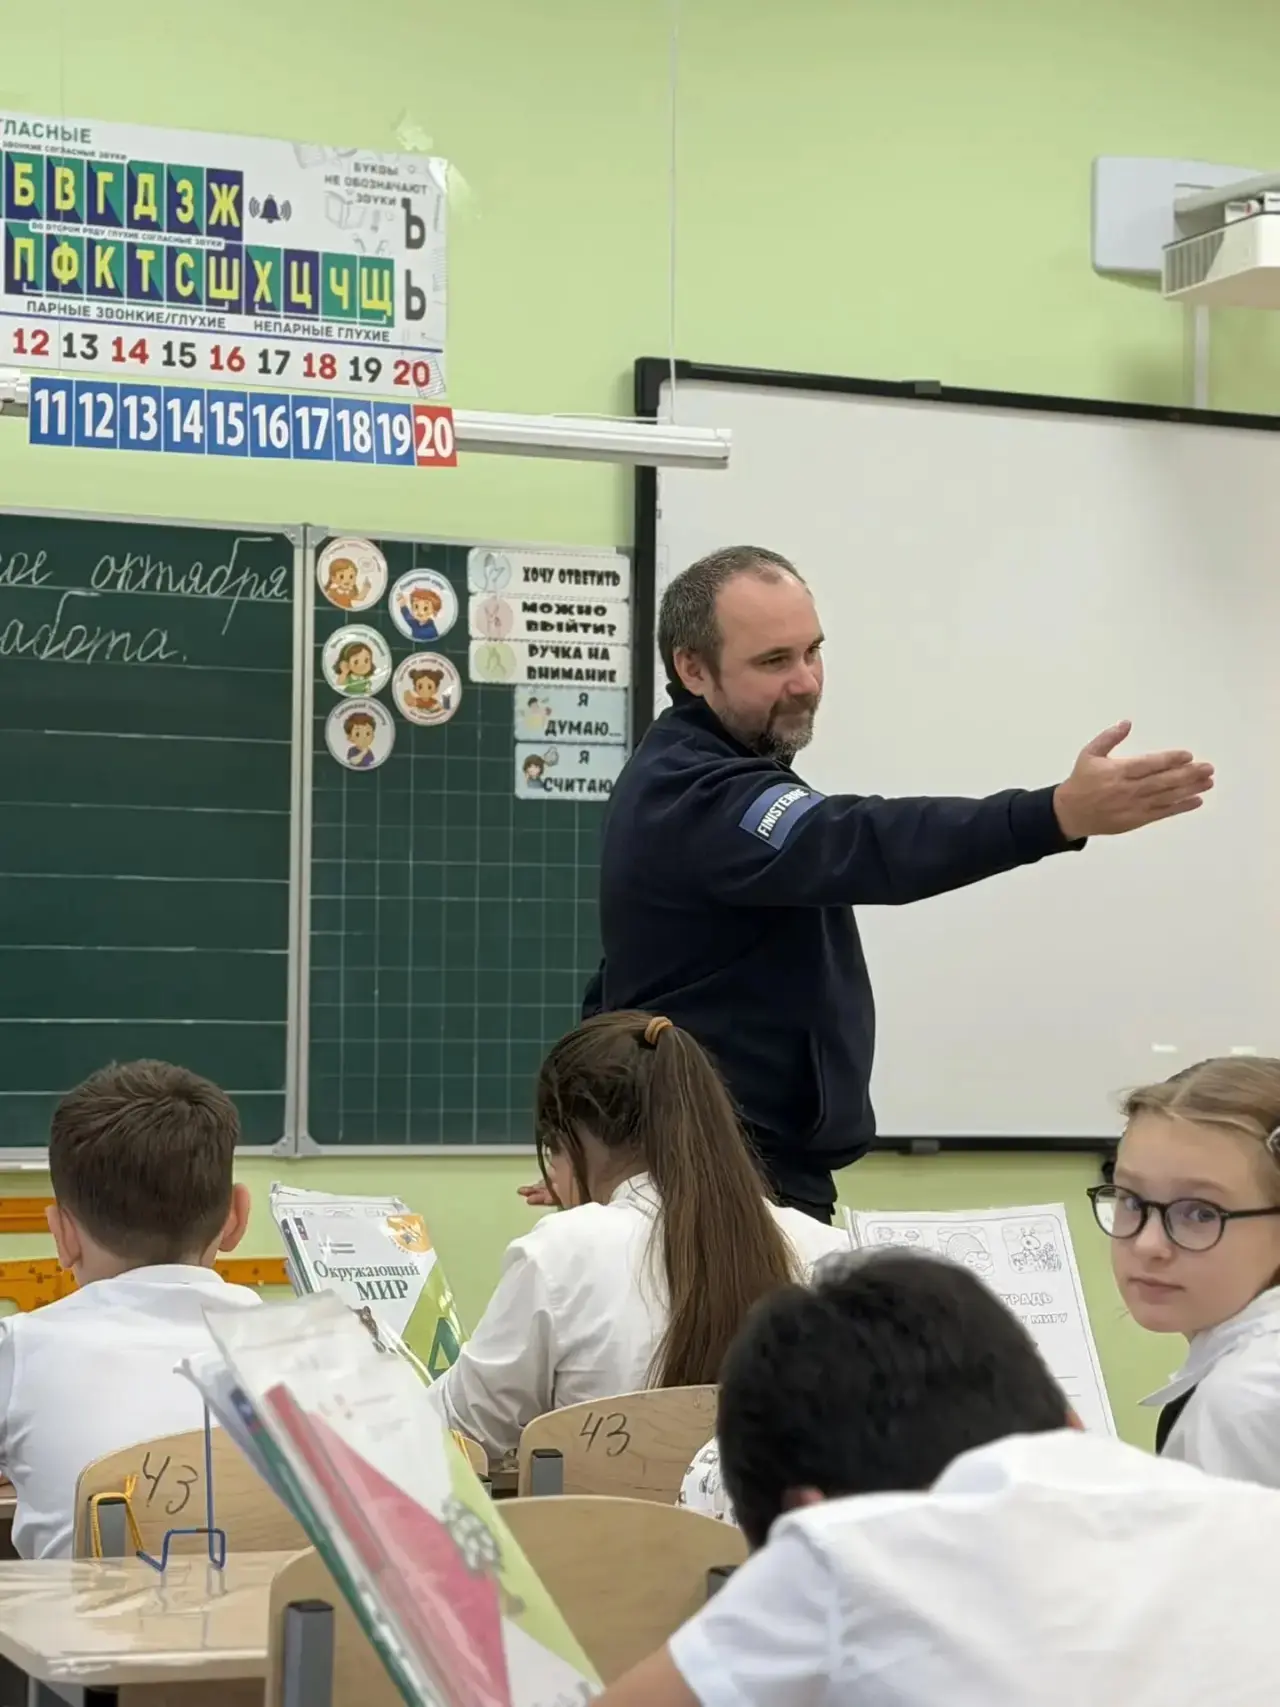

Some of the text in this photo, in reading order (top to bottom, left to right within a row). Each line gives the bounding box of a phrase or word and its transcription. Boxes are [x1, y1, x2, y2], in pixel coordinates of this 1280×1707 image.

[0, 118, 92, 144] ЛАСНЫЕ
[354, 162, 398, 175] БУКВЫ
[14, 162, 240, 228] Б В Г Д З Ж
[325, 175, 427, 195] НЕ ОБОЗНАЧАЮТ
[356, 193, 396, 205] ЗВУКИ
[401, 197, 426, 249] Ъ
[14, 237, 392, 316] П Ф К Т С Ш Х Ц Ч Щ
[405, 269, 426, 321] Ь
[27, 301, 226, 329] ПАРНЫЕ ЗВОНКИЕ/ГЛУХИЕ
[254, 320, 390, 343] НЕПАРНЫЕ ГЛУХИЕ
[13, 328, 430, 387] 12 13 14 15 16 17 18 19 20
[34, 389, 454, 459] 11 12 13 14 15 16 17 18 19 20
[0, 550, 53, 586] ое
[522, 566, 621, 587] ХОЧУ ОТВЕТИТЬ
[522, 601, 607, 616] МОЖНО
[526, 619, 617, 637] ВЫЙТИ?
[588, 648, 610, 661] НА
[527, 666, 617, 683] ВНИМАНИЕ
[578, 692, 589, 707] Я
[578, 750, 590, 765] Я
[543, 777, 614, 794] СЧИТАЮ
[313, 1260, 420, 1281] Окружающий
[354, 1280, 408, 1301] МИР
[579, 1412, 630, 1457] 43
[142, 1451, 198, 1515] 43
